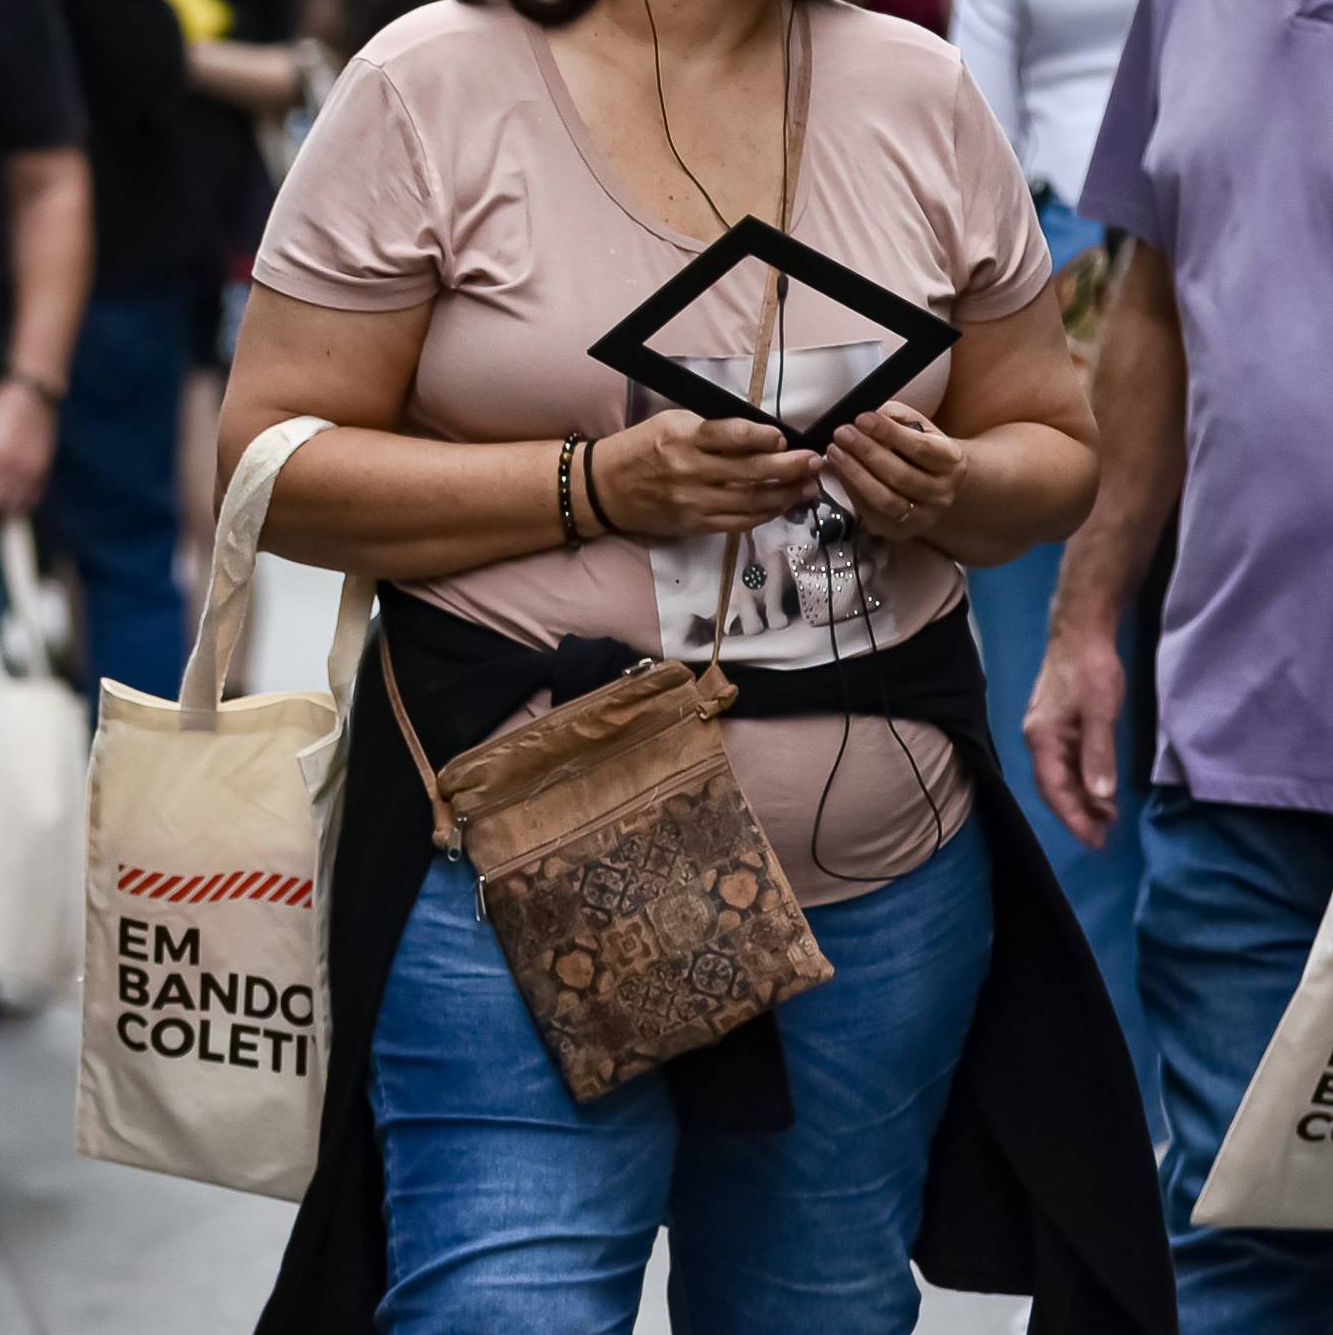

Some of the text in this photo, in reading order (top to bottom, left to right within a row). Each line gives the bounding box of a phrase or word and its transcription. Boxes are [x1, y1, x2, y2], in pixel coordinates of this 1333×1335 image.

[117, 916, 201, 966] EM
[117, 963, 314, 1028] BANDO
[116, 1011, 315, 1077] COLETI
